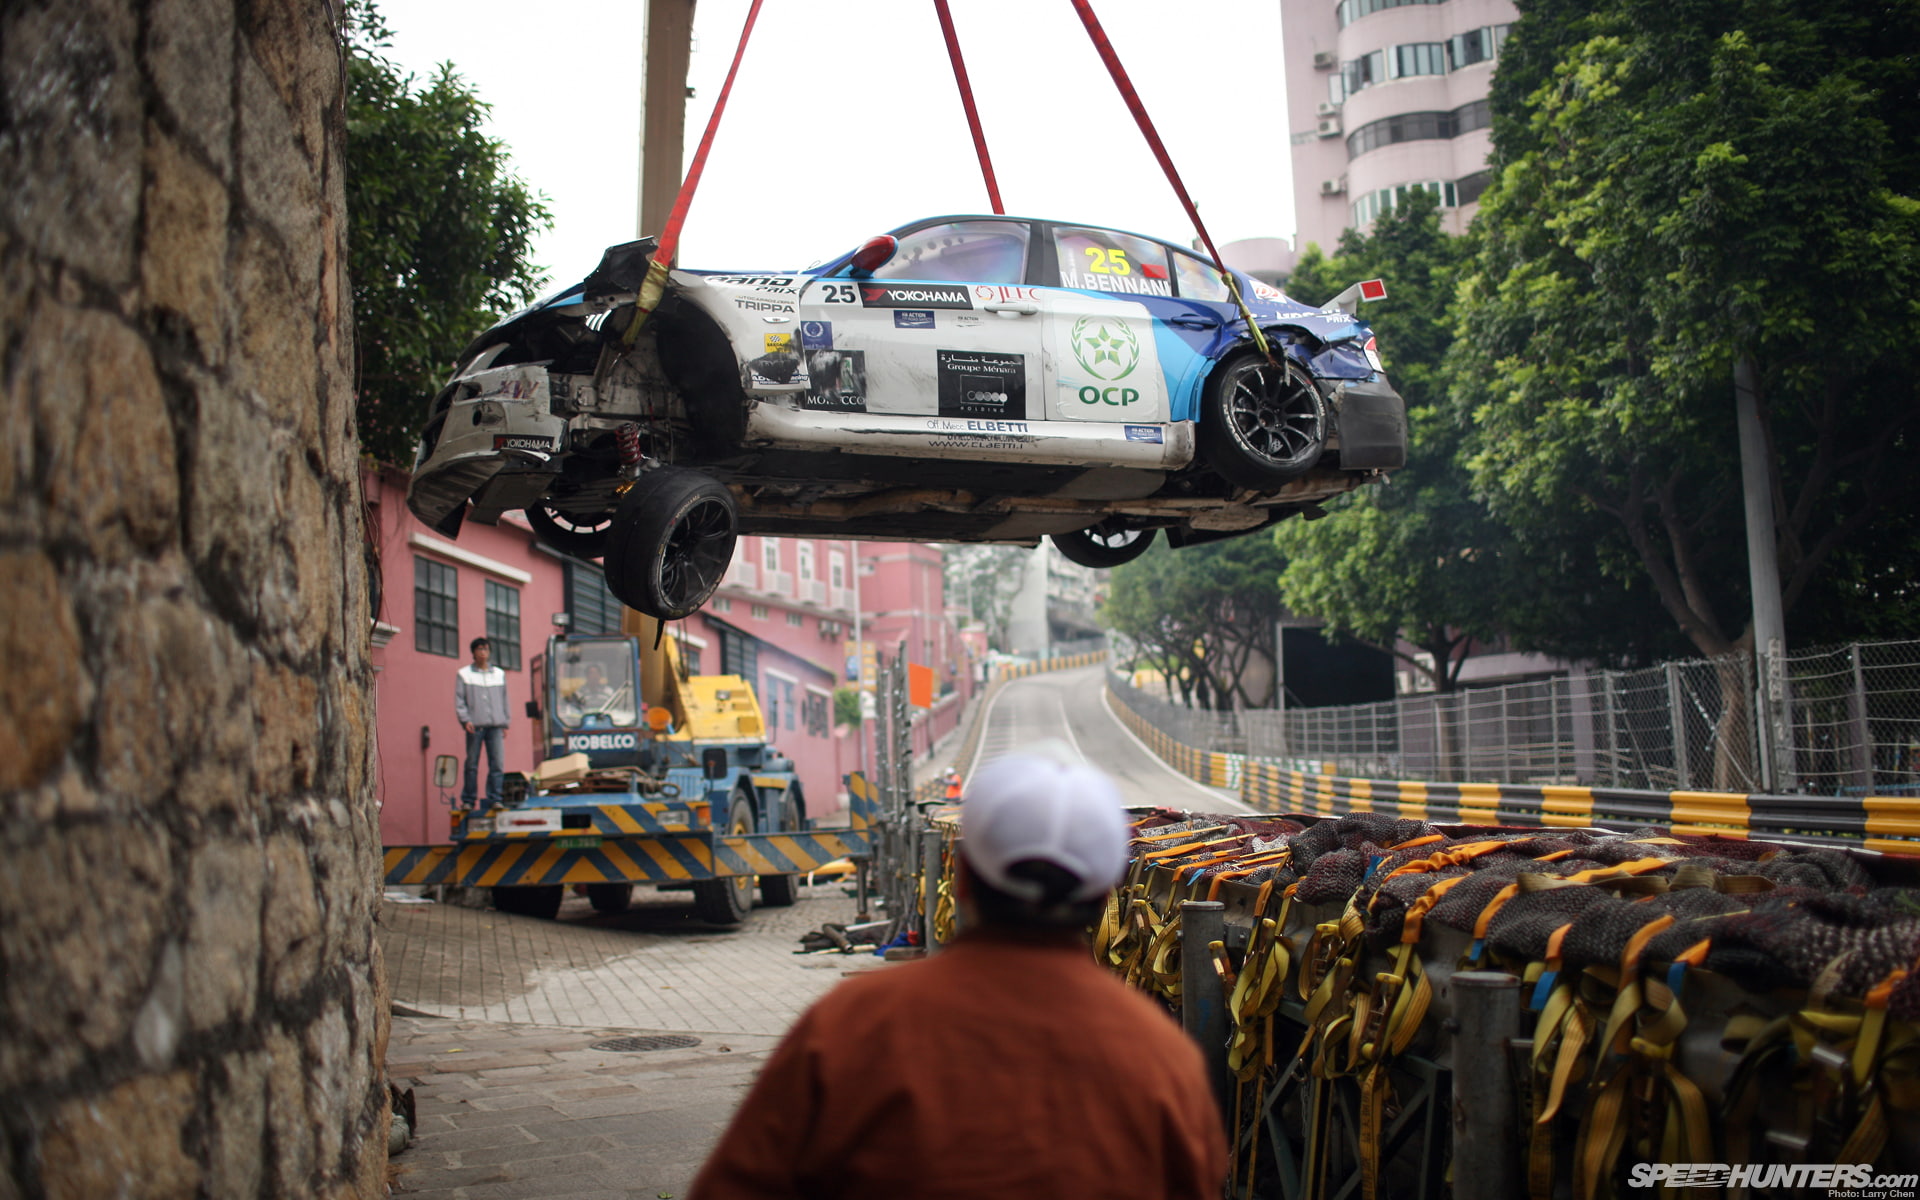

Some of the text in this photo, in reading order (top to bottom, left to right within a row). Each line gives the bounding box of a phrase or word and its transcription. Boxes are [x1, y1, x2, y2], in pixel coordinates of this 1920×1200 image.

[1085, 247, 1131, 276] 25
[1060, 271, 1173, 297] M.BENNANI
[822, 284, 856, 303] 25
[887, 290, 967, 303] YOKOHAMA
[734, 299, 795, 314] TRIPPA
[947, 363, 981, 373] Groupe
[807, 395, 865, 405] MOCCO
[1079, 386, 1139, 406] OCP
[967, 420, 1029, 433] ELBETTI
[507, 439, 551, 449] YOKOHAMA
[568, 734, 635, 750] KOBELCO
